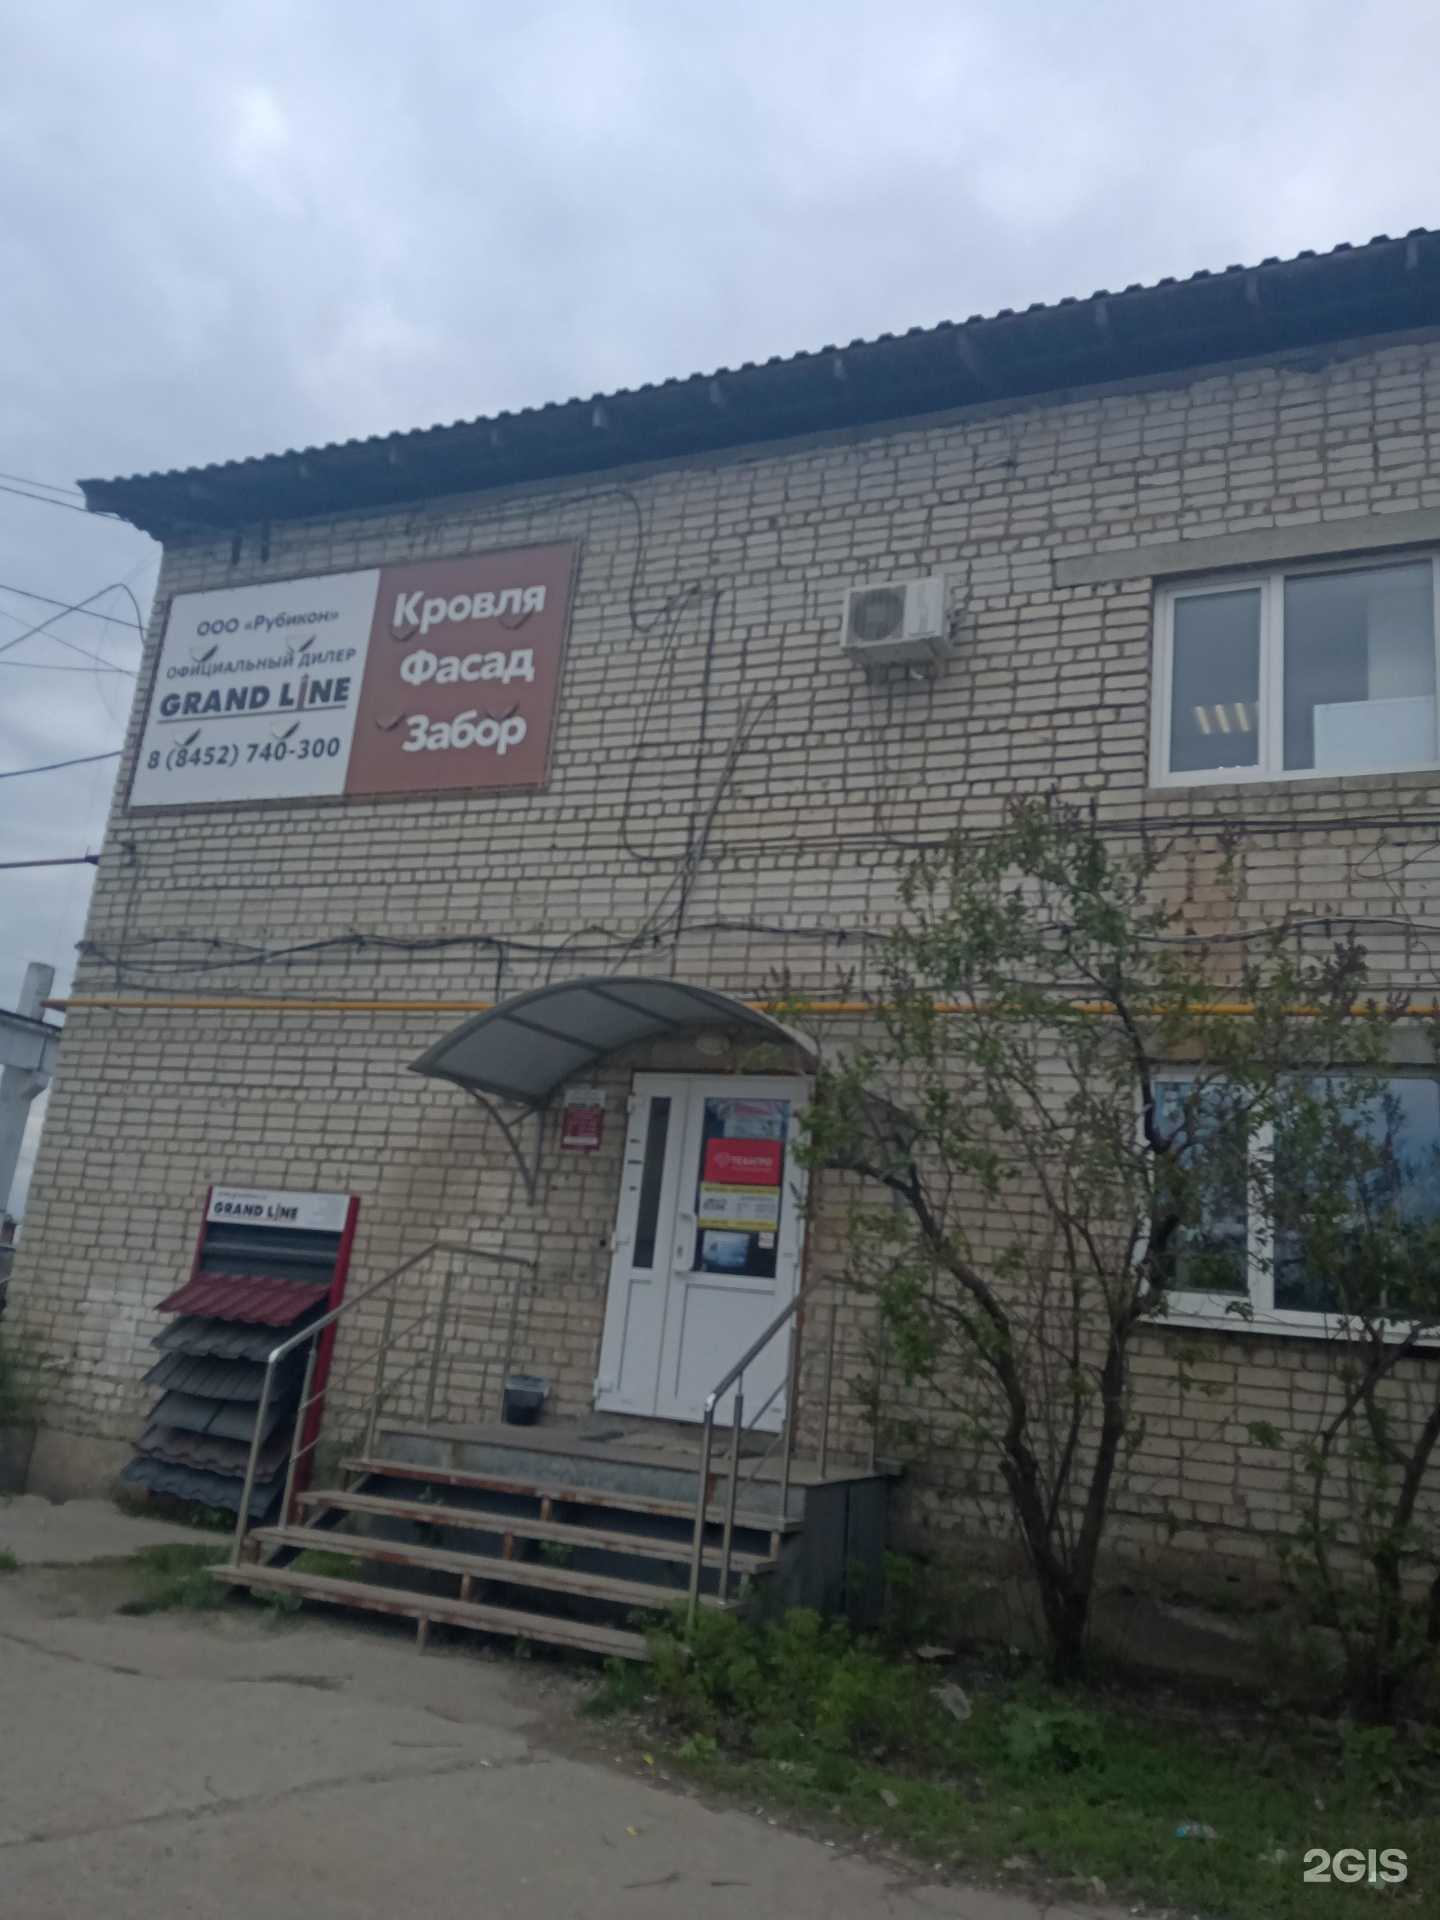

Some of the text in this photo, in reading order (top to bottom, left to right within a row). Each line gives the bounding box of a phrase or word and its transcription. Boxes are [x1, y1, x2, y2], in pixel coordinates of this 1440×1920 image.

[196, 610, 339, 636] ООО «Рубикон»
[393, 585, 547, 634] Кровля
[166, 648, 357, 679] ОФИЦИАЛЬНЫЙ ДИЛЕР
[400, 648, 535, 686] Фасад
[159, 685, 270, 716] GRAND
[402, 709, 527, 755] Забор
[247, 737, 341, 762] 740-300
[214, 1201, 264, 1217] GRAND
